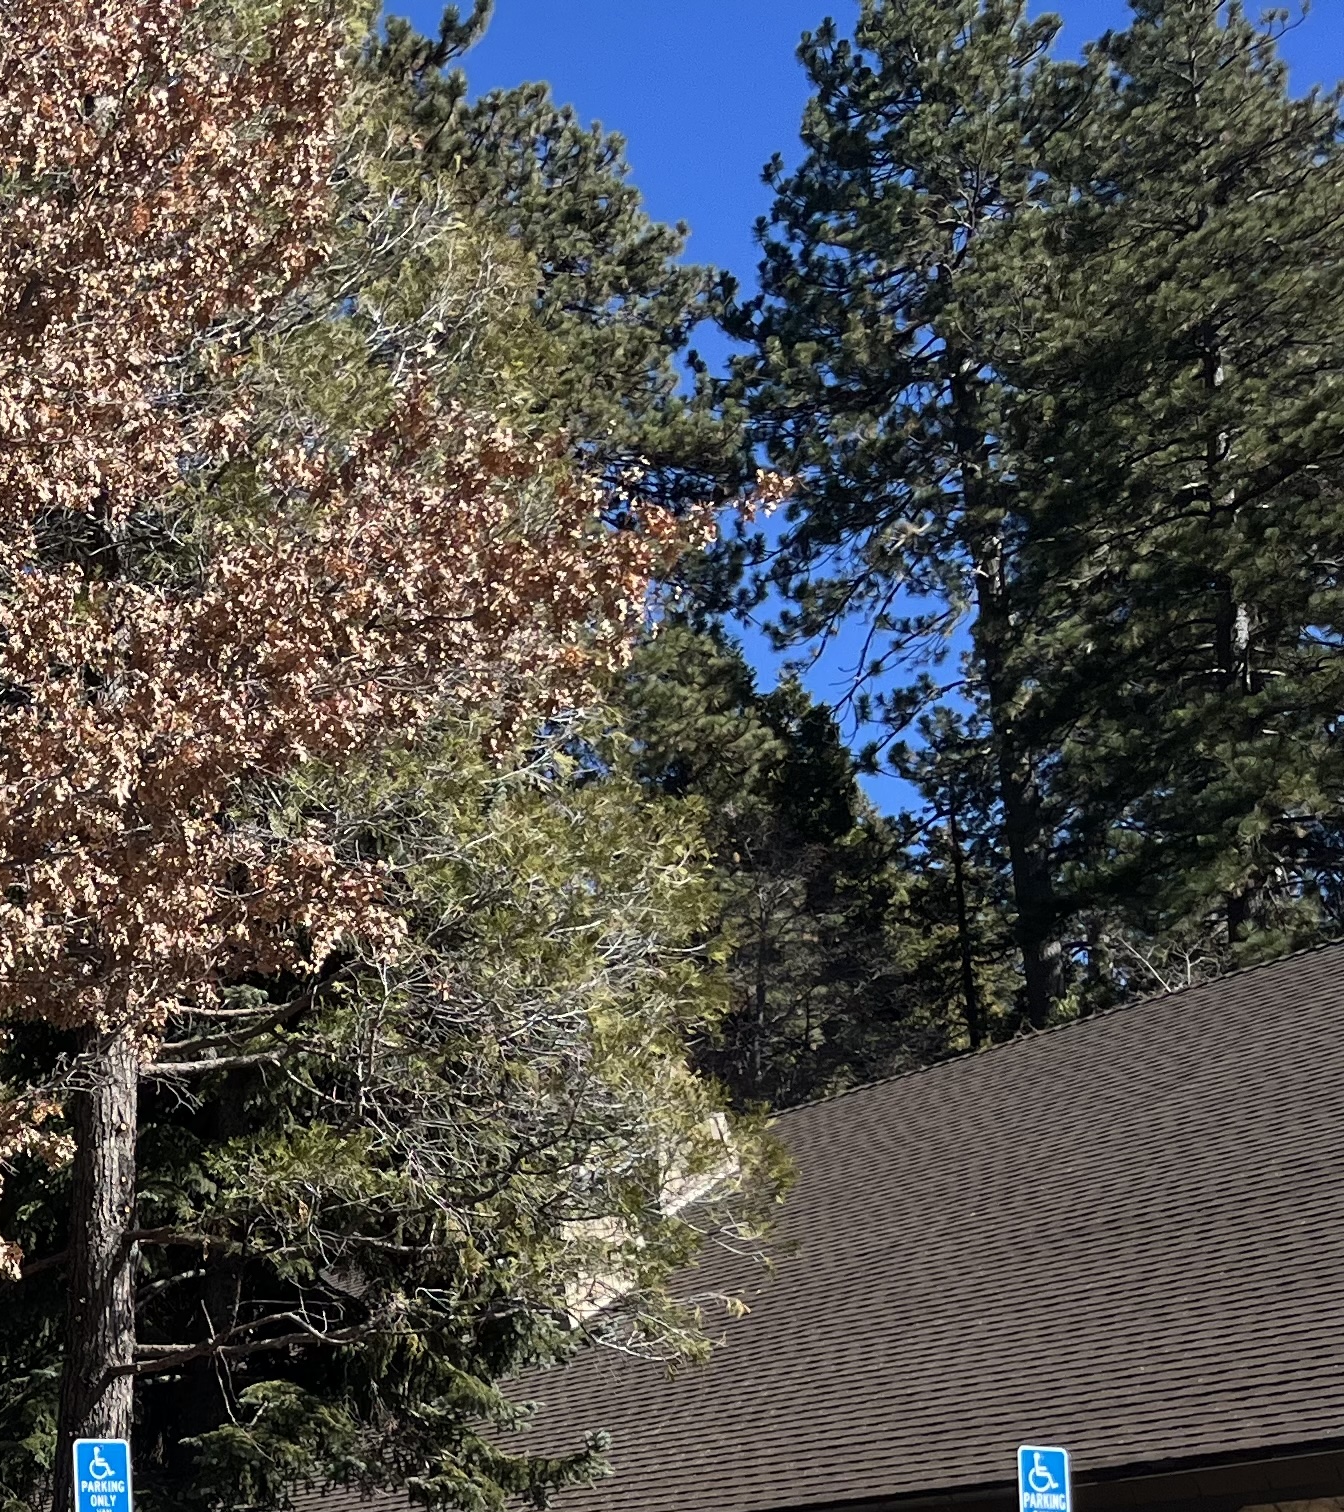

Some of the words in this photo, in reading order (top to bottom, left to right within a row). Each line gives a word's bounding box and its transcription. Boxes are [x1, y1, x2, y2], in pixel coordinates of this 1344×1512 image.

[81, 1480, 125, 1493] PARKING
[90, 1494, 117, 1507] ONLY
[1023, 1492, 1066, 1510] PARKING
